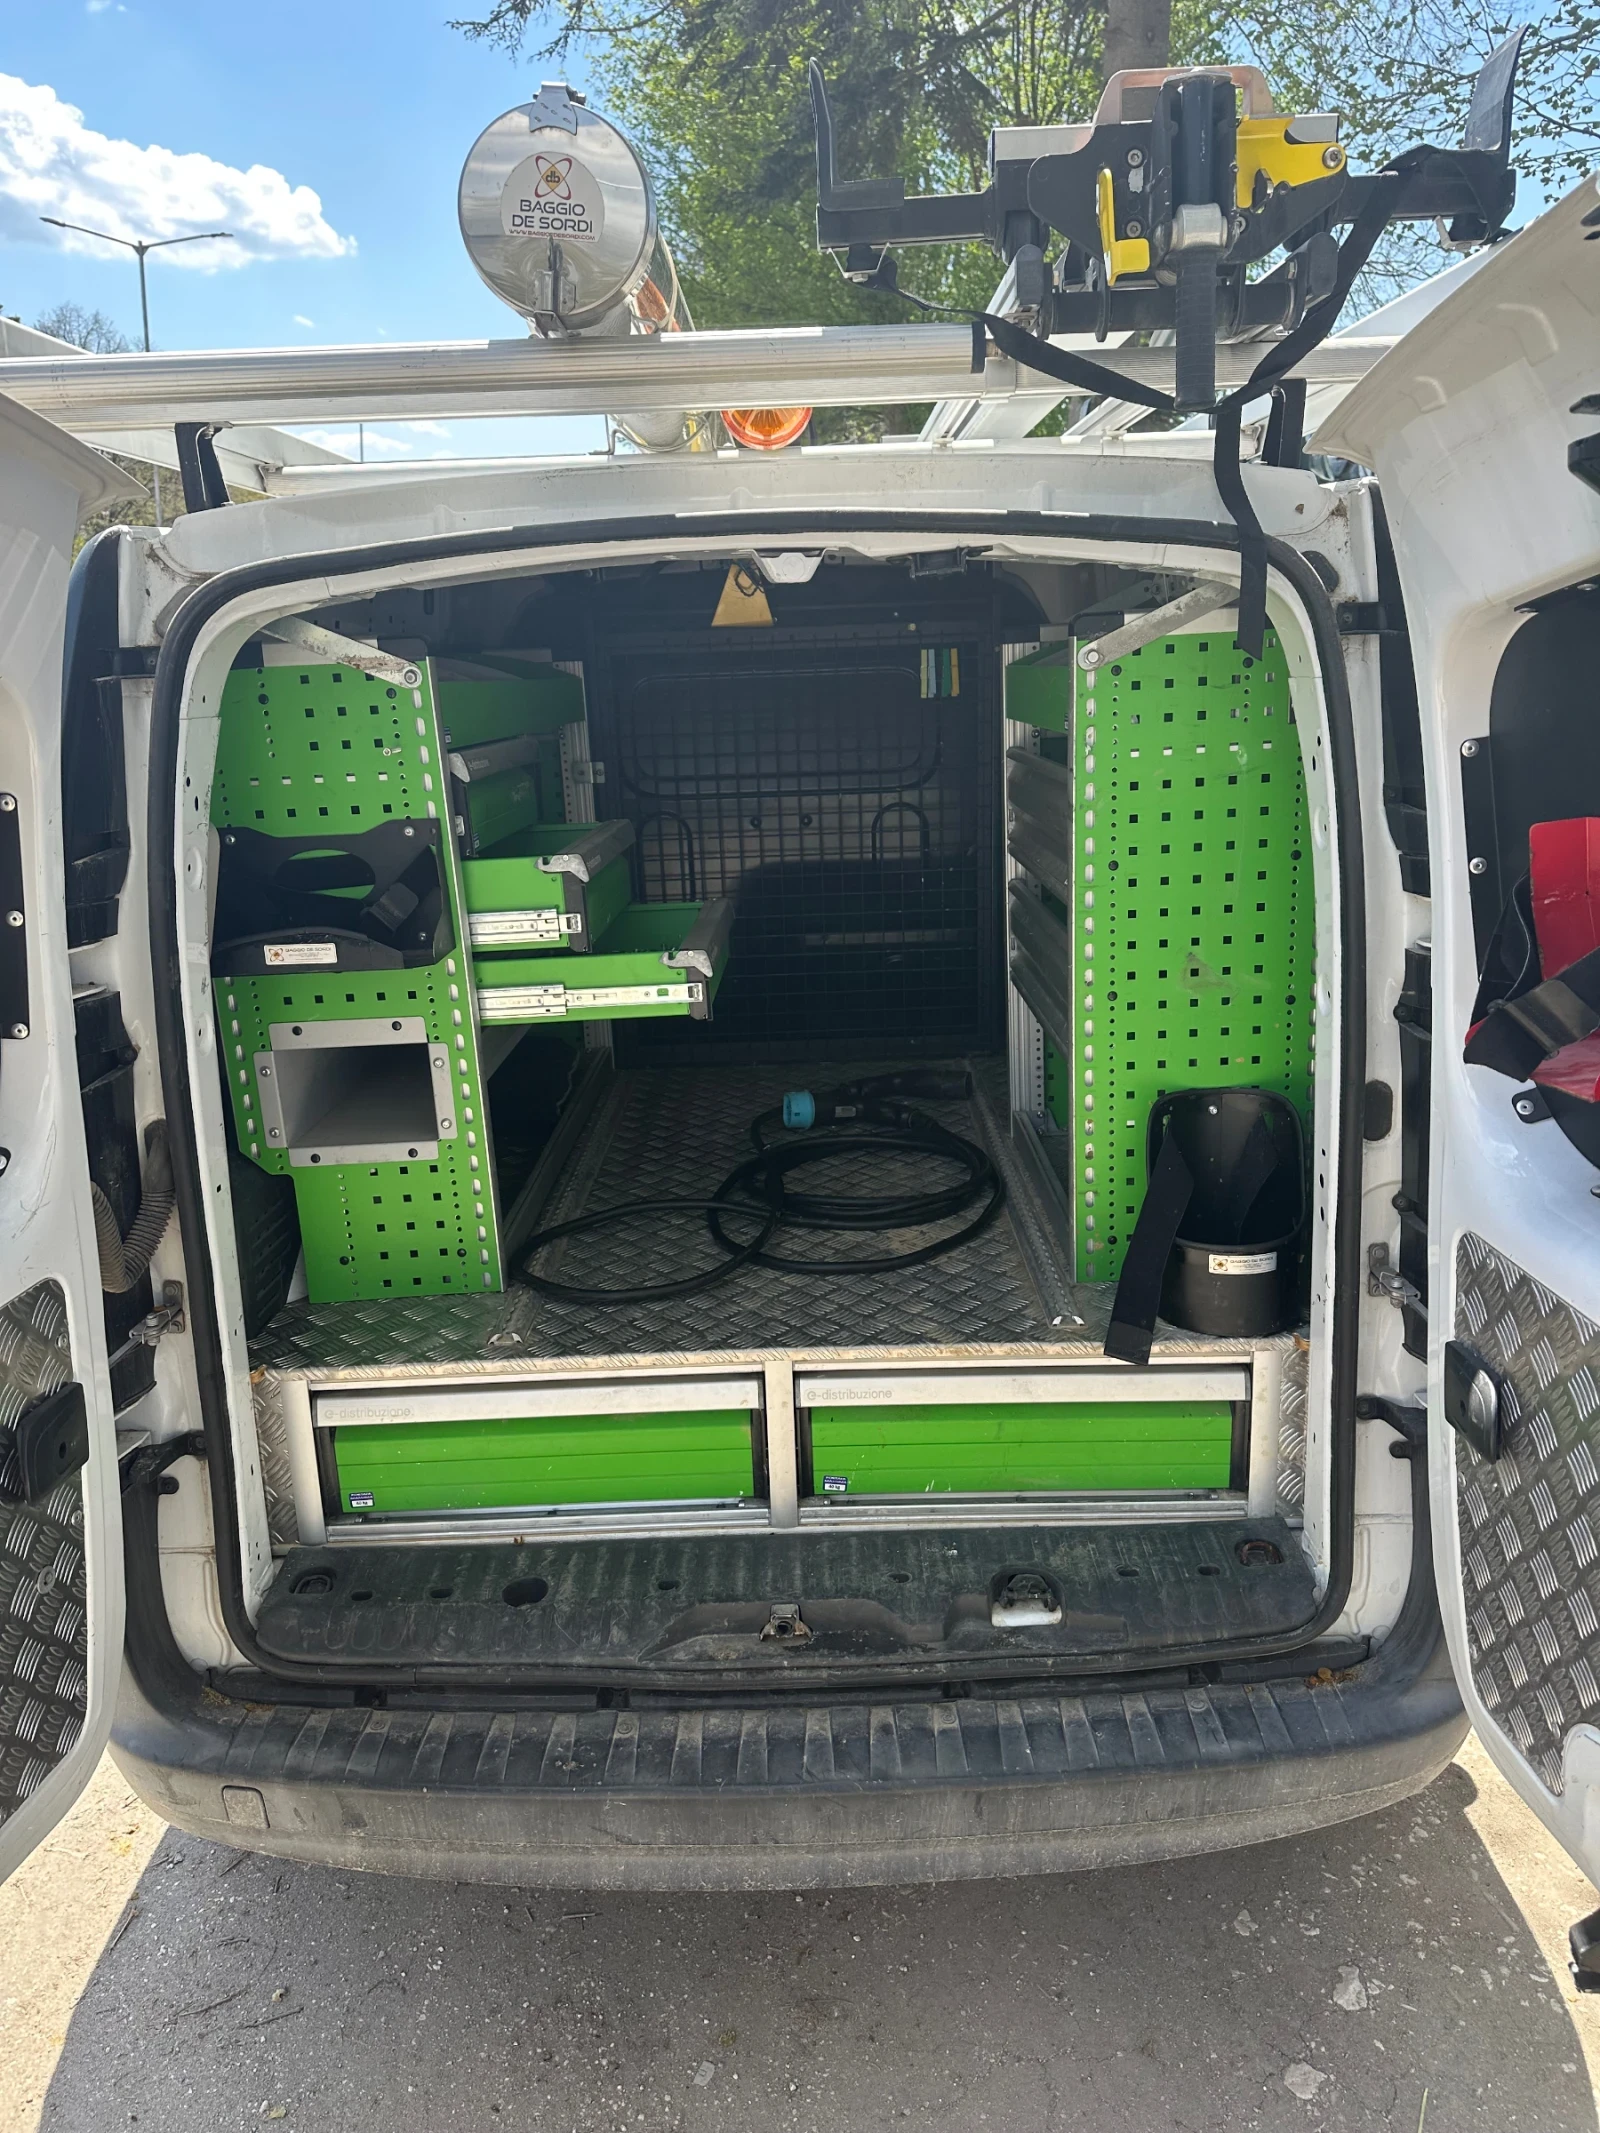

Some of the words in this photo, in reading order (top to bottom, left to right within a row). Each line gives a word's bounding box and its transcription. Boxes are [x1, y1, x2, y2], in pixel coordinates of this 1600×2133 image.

[519, 199, 586, 217] BAGGIO
[512, 214, 535, 228] DE
[539, 217, 593, 233] SORDI
[807, 1388, 893, 1401] e-distribuzione
